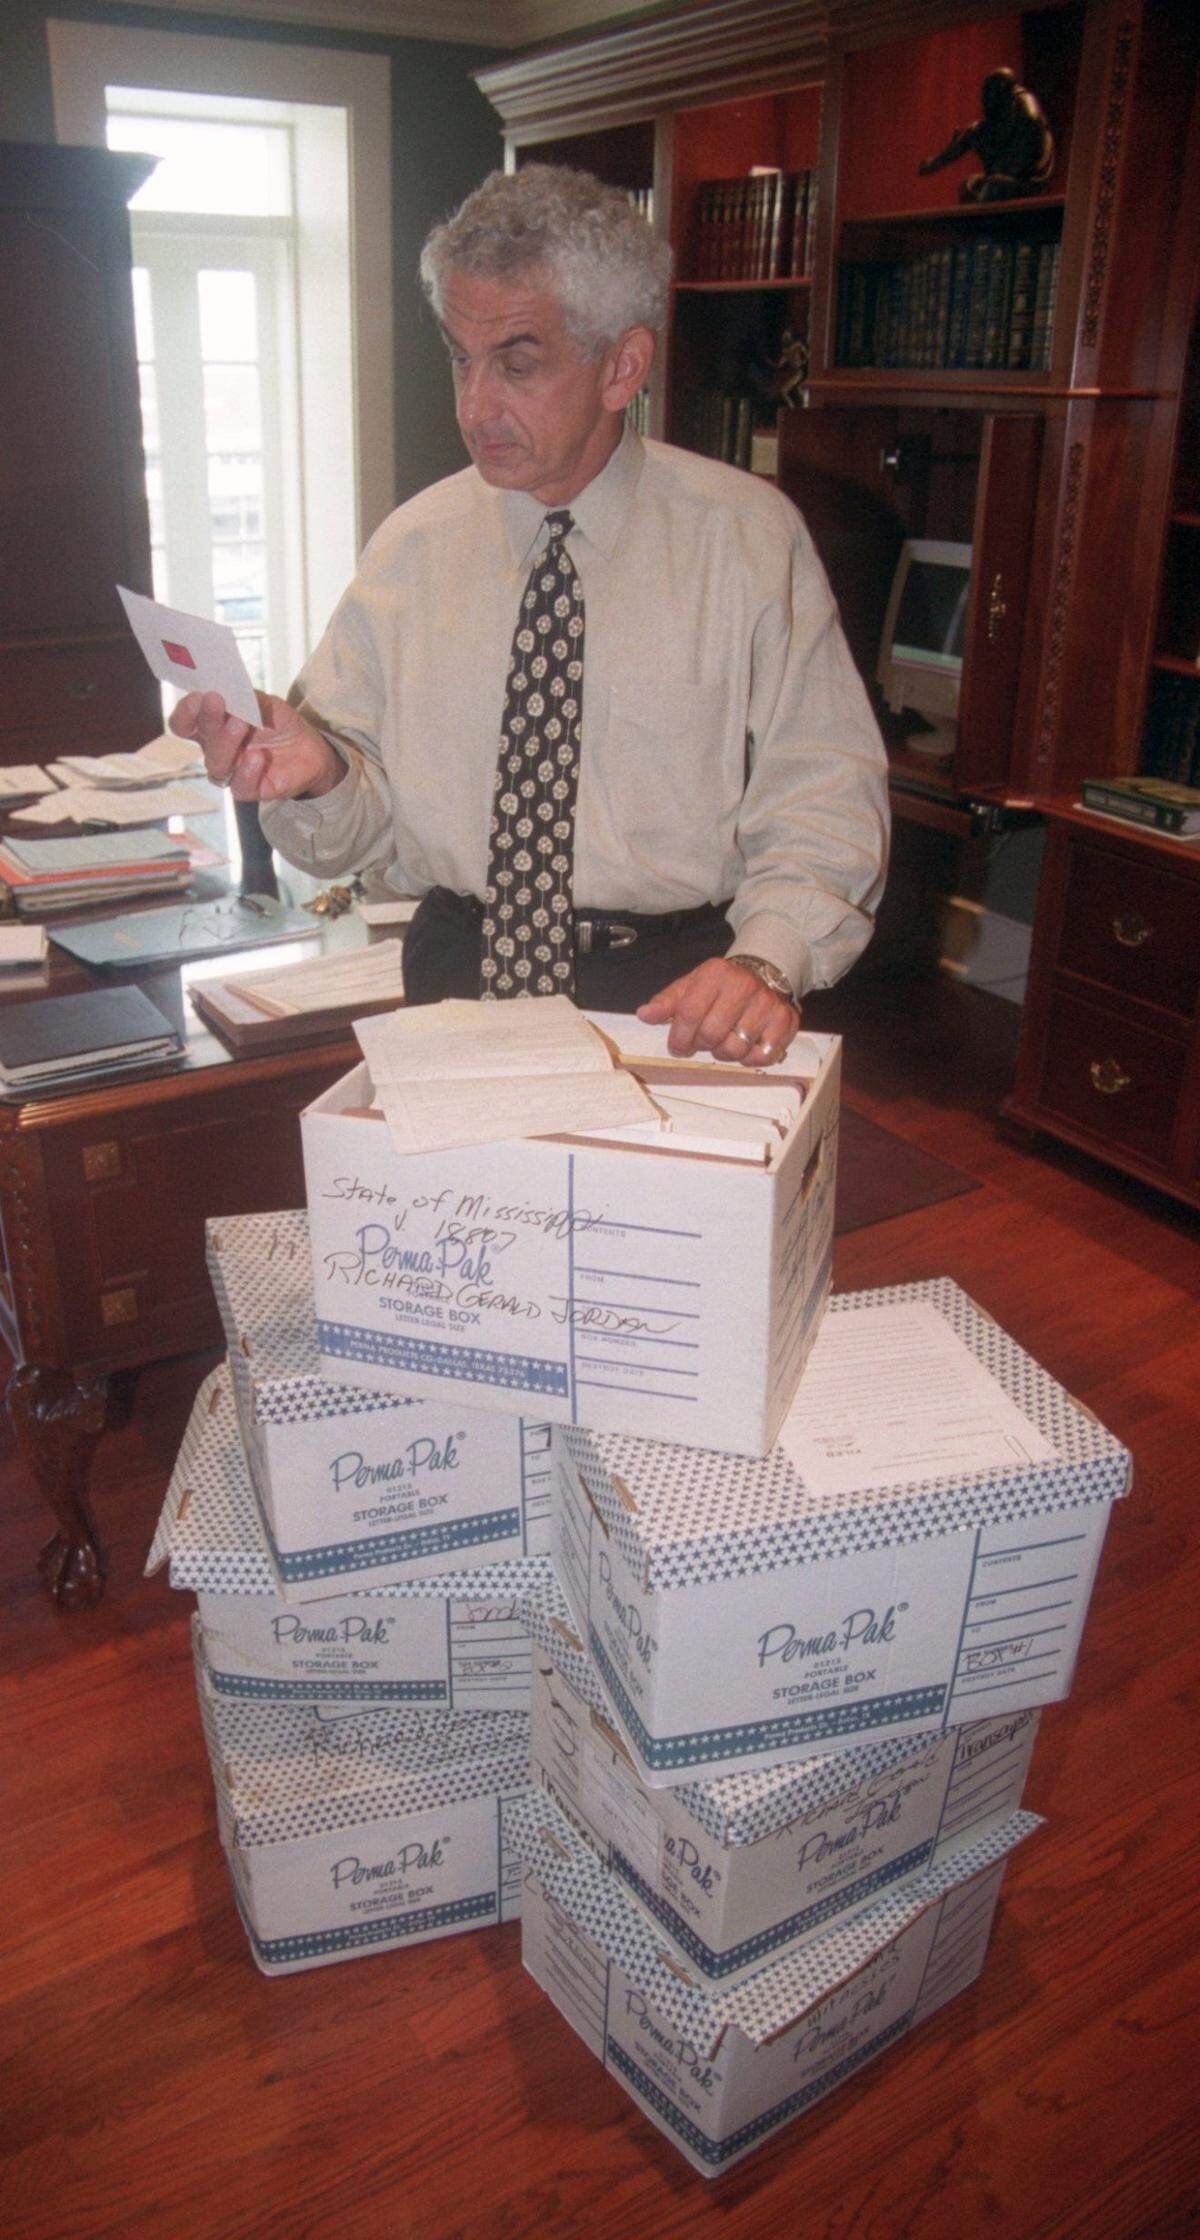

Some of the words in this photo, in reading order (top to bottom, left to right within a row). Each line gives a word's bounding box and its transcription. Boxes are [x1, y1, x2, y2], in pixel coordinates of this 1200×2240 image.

[412, 1190, 454, 1213] of
[378, 1295, 444, 1319] STORAGE
[449, 1308, 482, 1326] BOX
[353, 1500, 415, 1522] STORAGE
[418, 1493, 449, 1509] BOX
[292, 1660, 347, 1669] STORAGE
[351, 1660, 379, 1669] BOX
[772, 1677, 840, 1699] STORAGE
[845, 1668, 877, 1685] BOX
[350, 1891, 404, 1912] STORAGE
[407, 1885, 434, 1900] BOX
